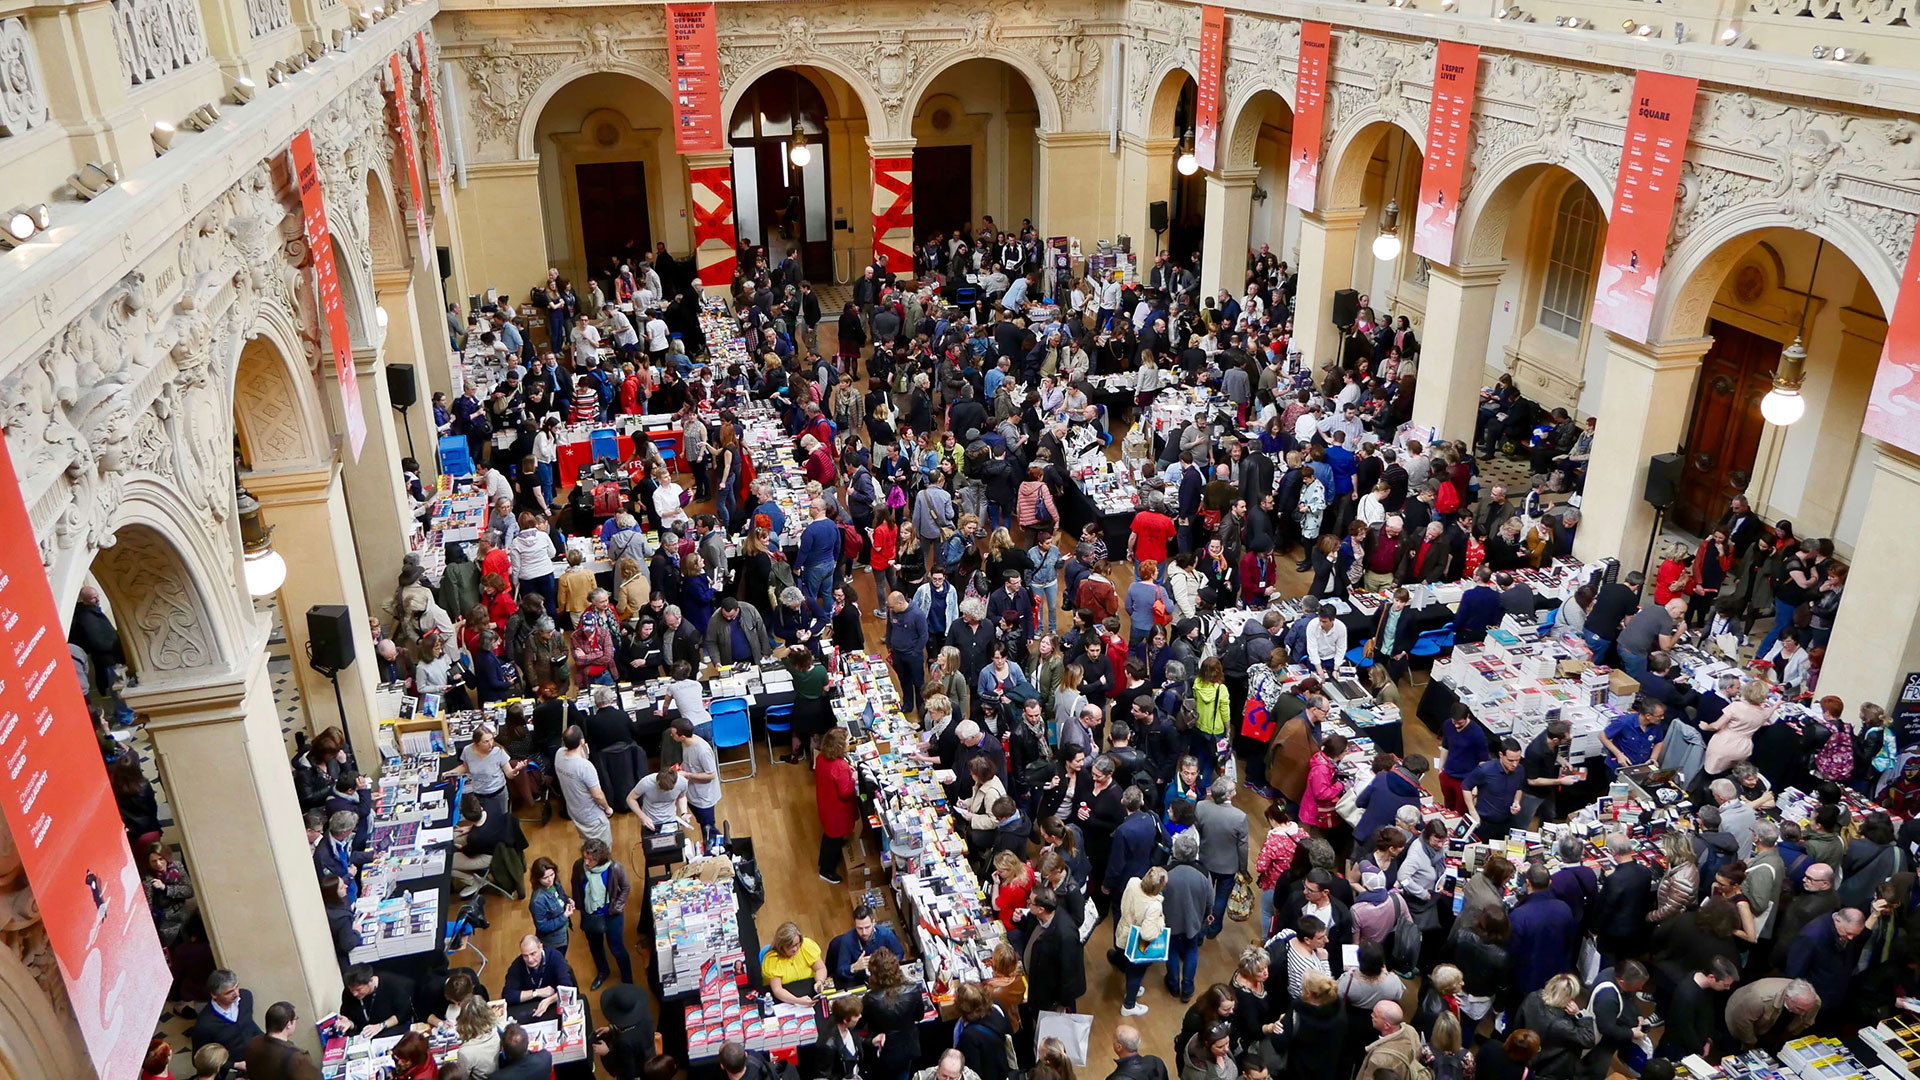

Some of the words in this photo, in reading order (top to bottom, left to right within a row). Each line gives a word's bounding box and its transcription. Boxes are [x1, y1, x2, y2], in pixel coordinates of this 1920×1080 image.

[1640, 97, 1650, 106] LE
[1638, 107, 1670, 121] SQUARE
[5, 612, 19, 633] PARIS
[28, 658, 57, 702] TOURANCHEAU
[11, 753, 27, 780] GRAND
